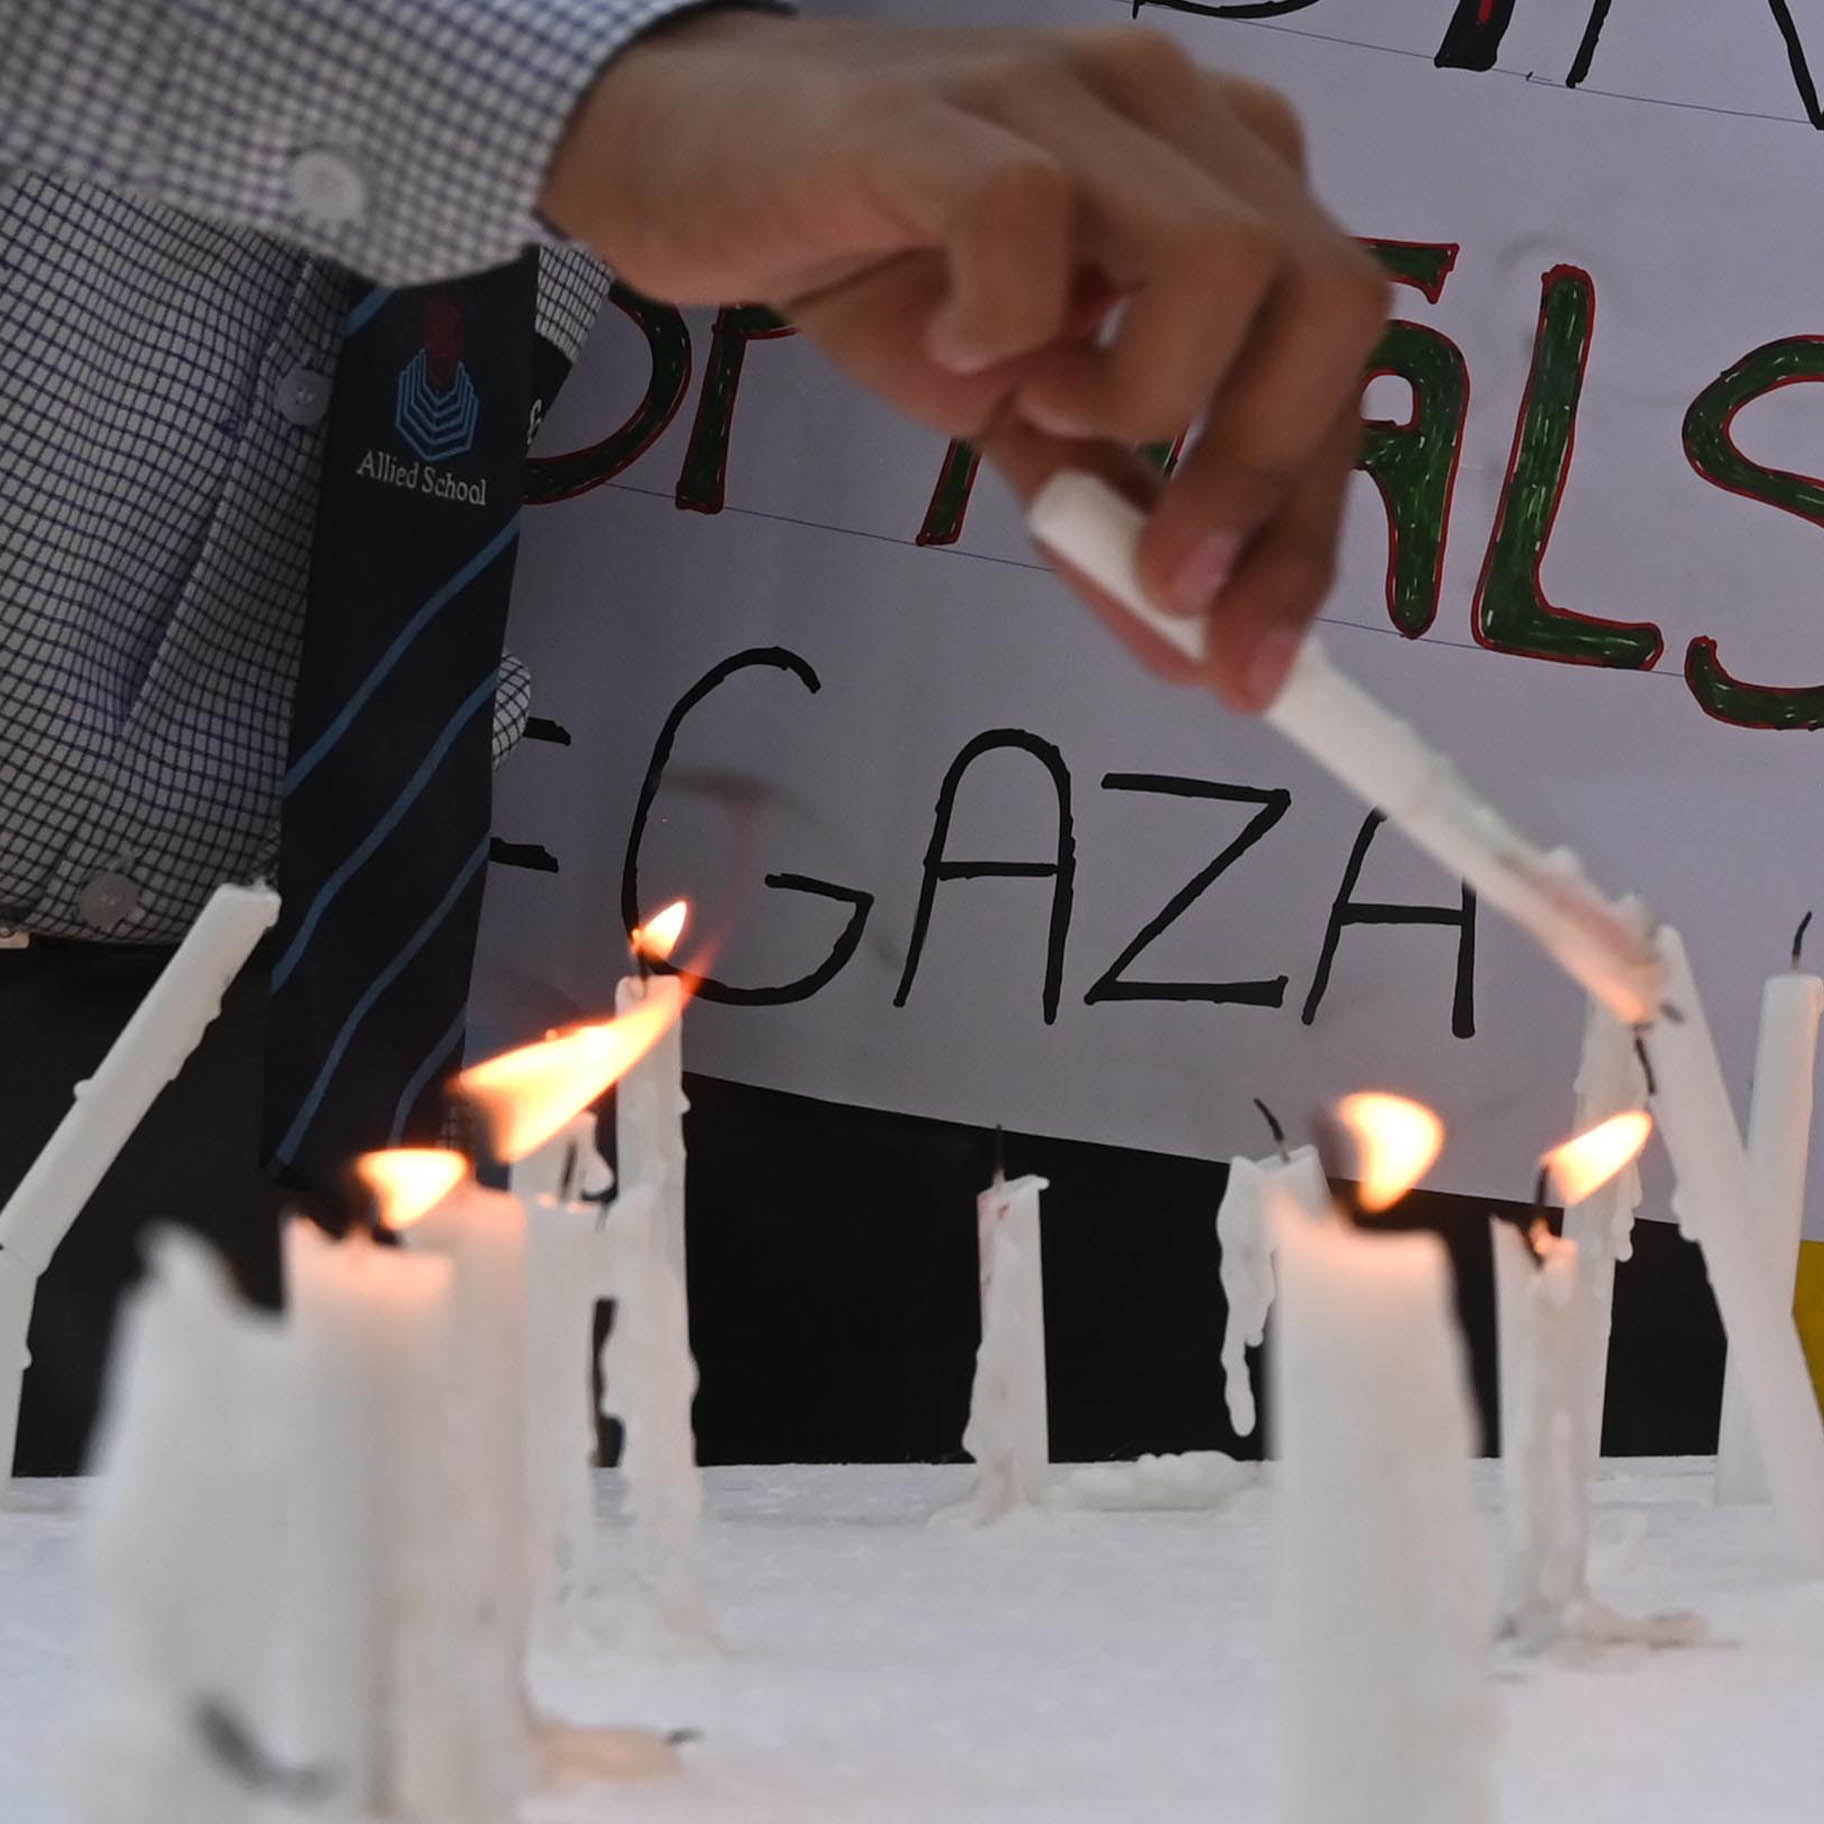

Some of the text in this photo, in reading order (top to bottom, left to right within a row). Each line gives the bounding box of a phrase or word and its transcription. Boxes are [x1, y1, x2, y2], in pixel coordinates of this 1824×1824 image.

[356, 450, 487, 507] Allied School
[622, 646, 1477, 1038] GAZA
